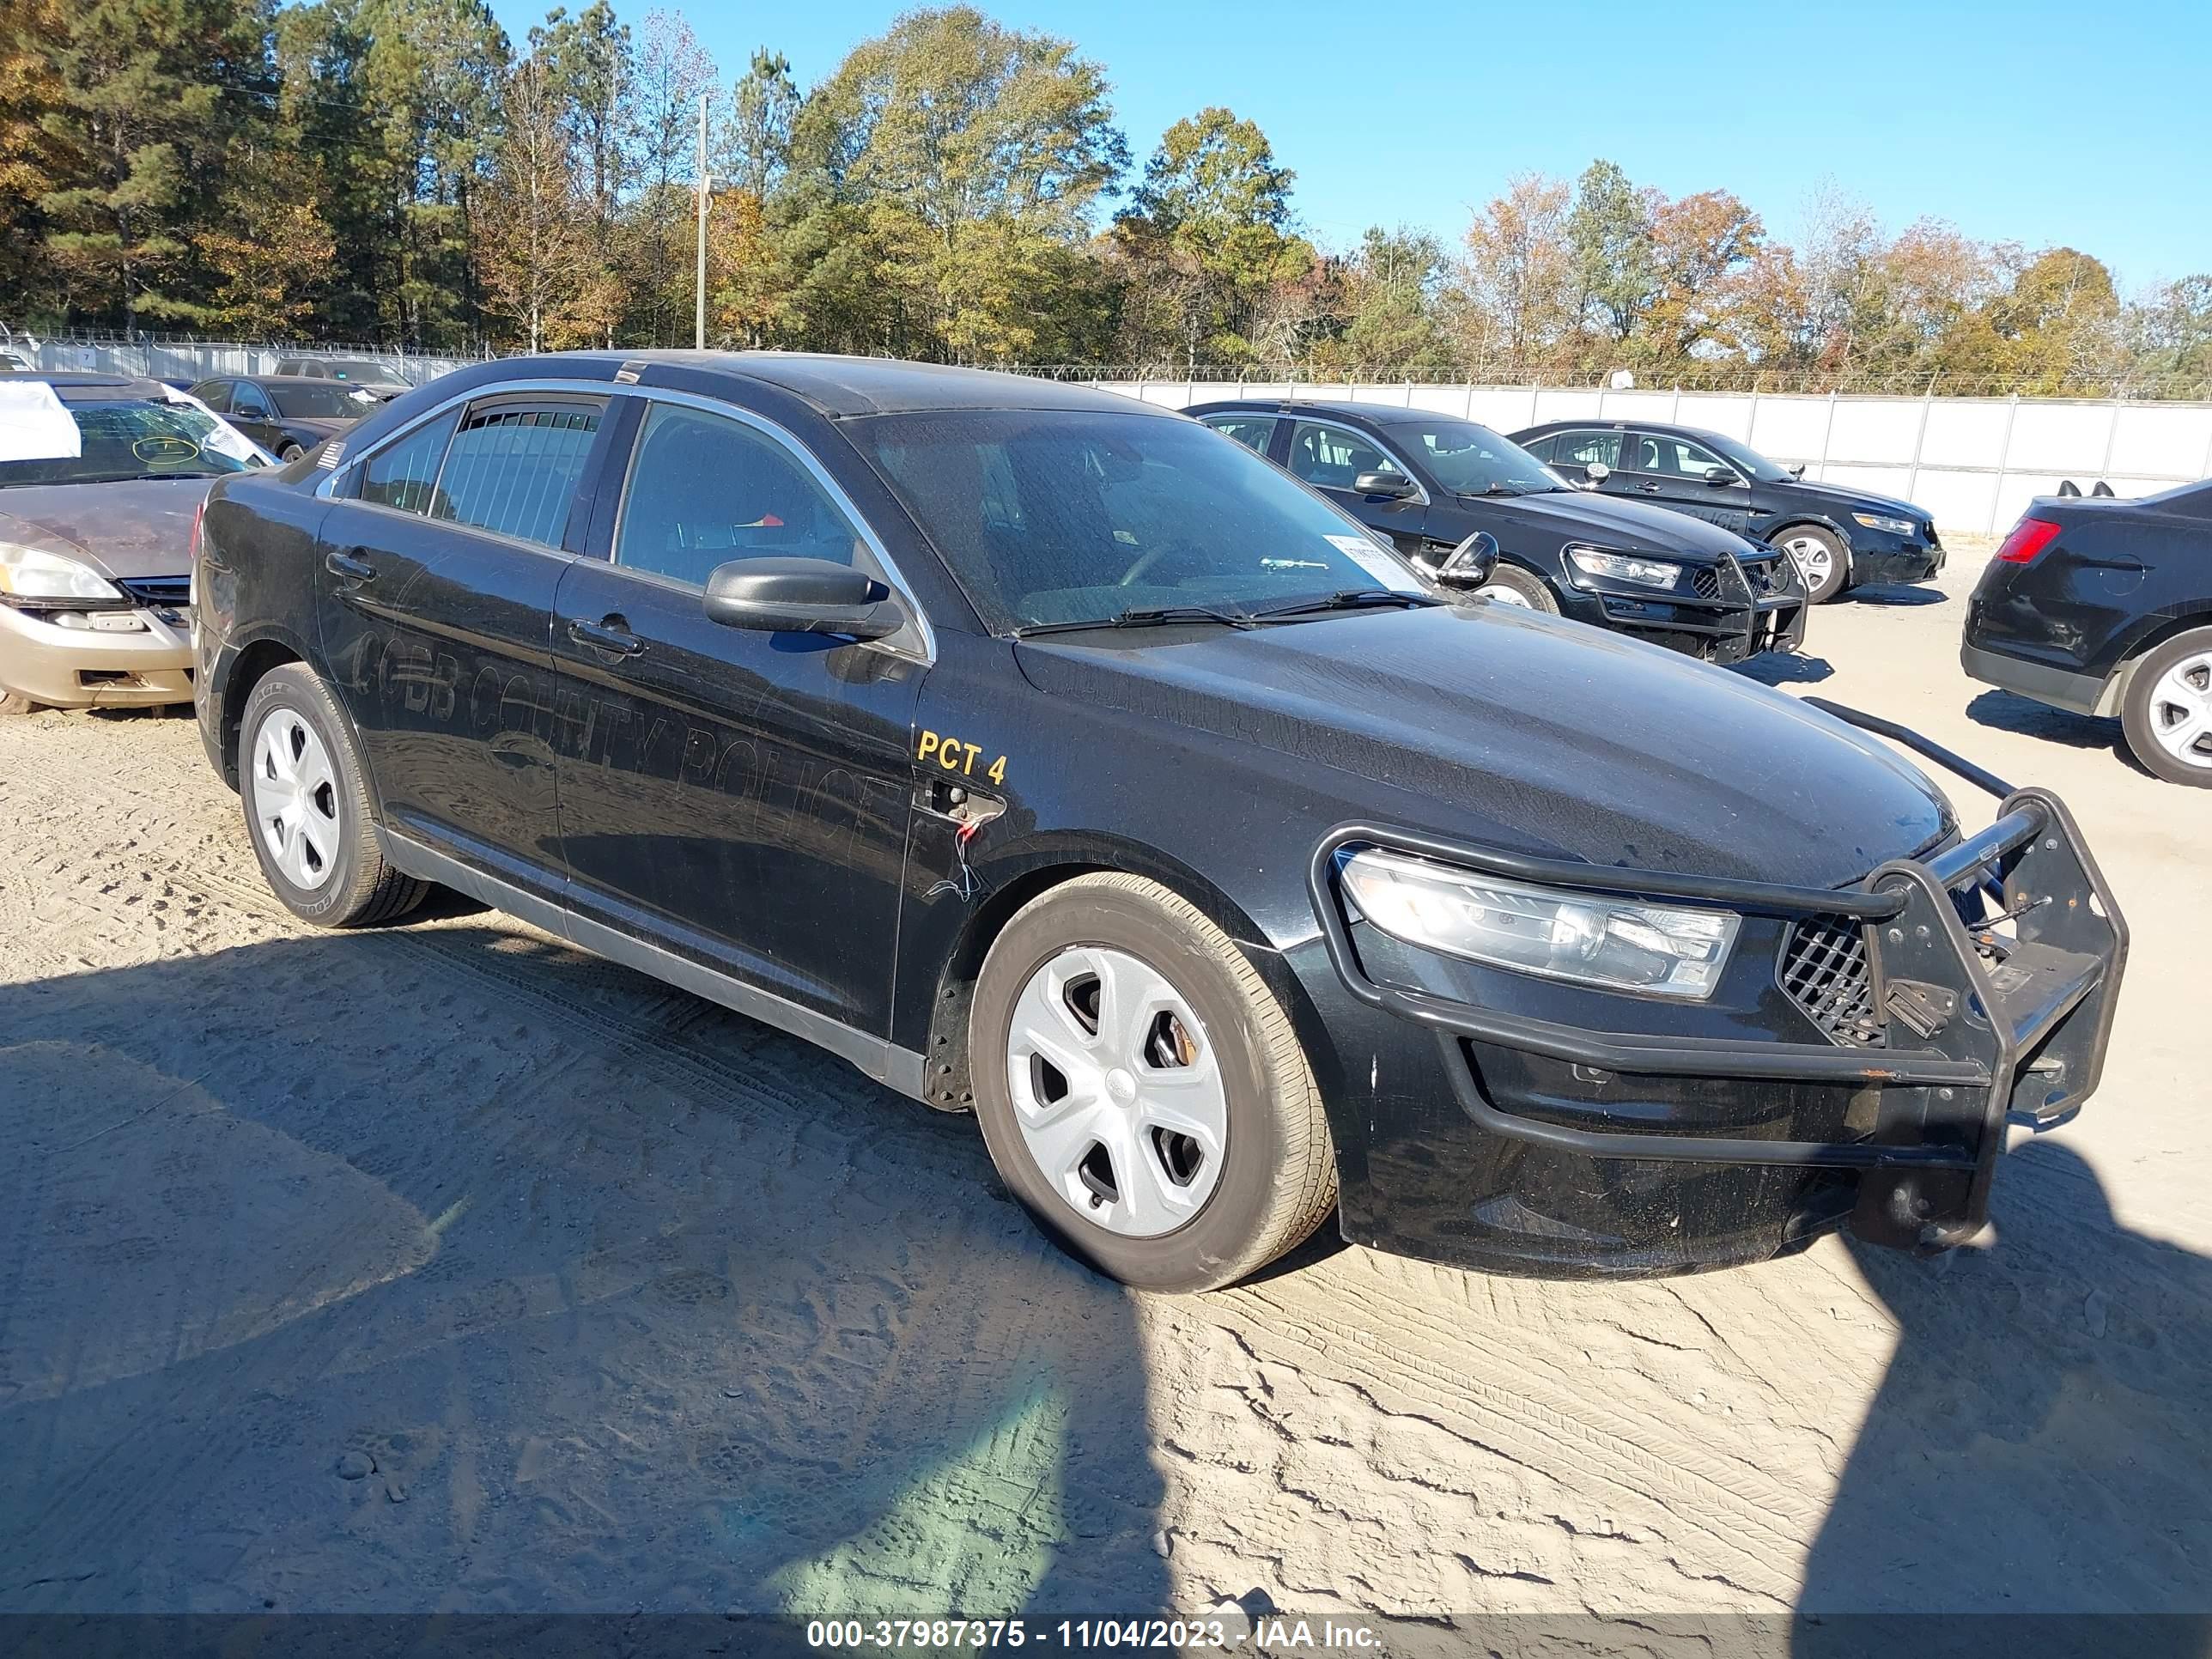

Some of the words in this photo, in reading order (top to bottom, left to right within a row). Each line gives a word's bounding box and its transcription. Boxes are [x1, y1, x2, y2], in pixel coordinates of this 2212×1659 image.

[1675, 507, 1741, 531] OLICE
[252, 682, 290, 714] AGLE
[351, 631, 459, 723] COBB
[470, 666, 667, 777] COUNTY
[674, 727, 904, 860] POLICE
[917, 730, 982, 775] PCT
[988, 755, 1007, 786] 4
